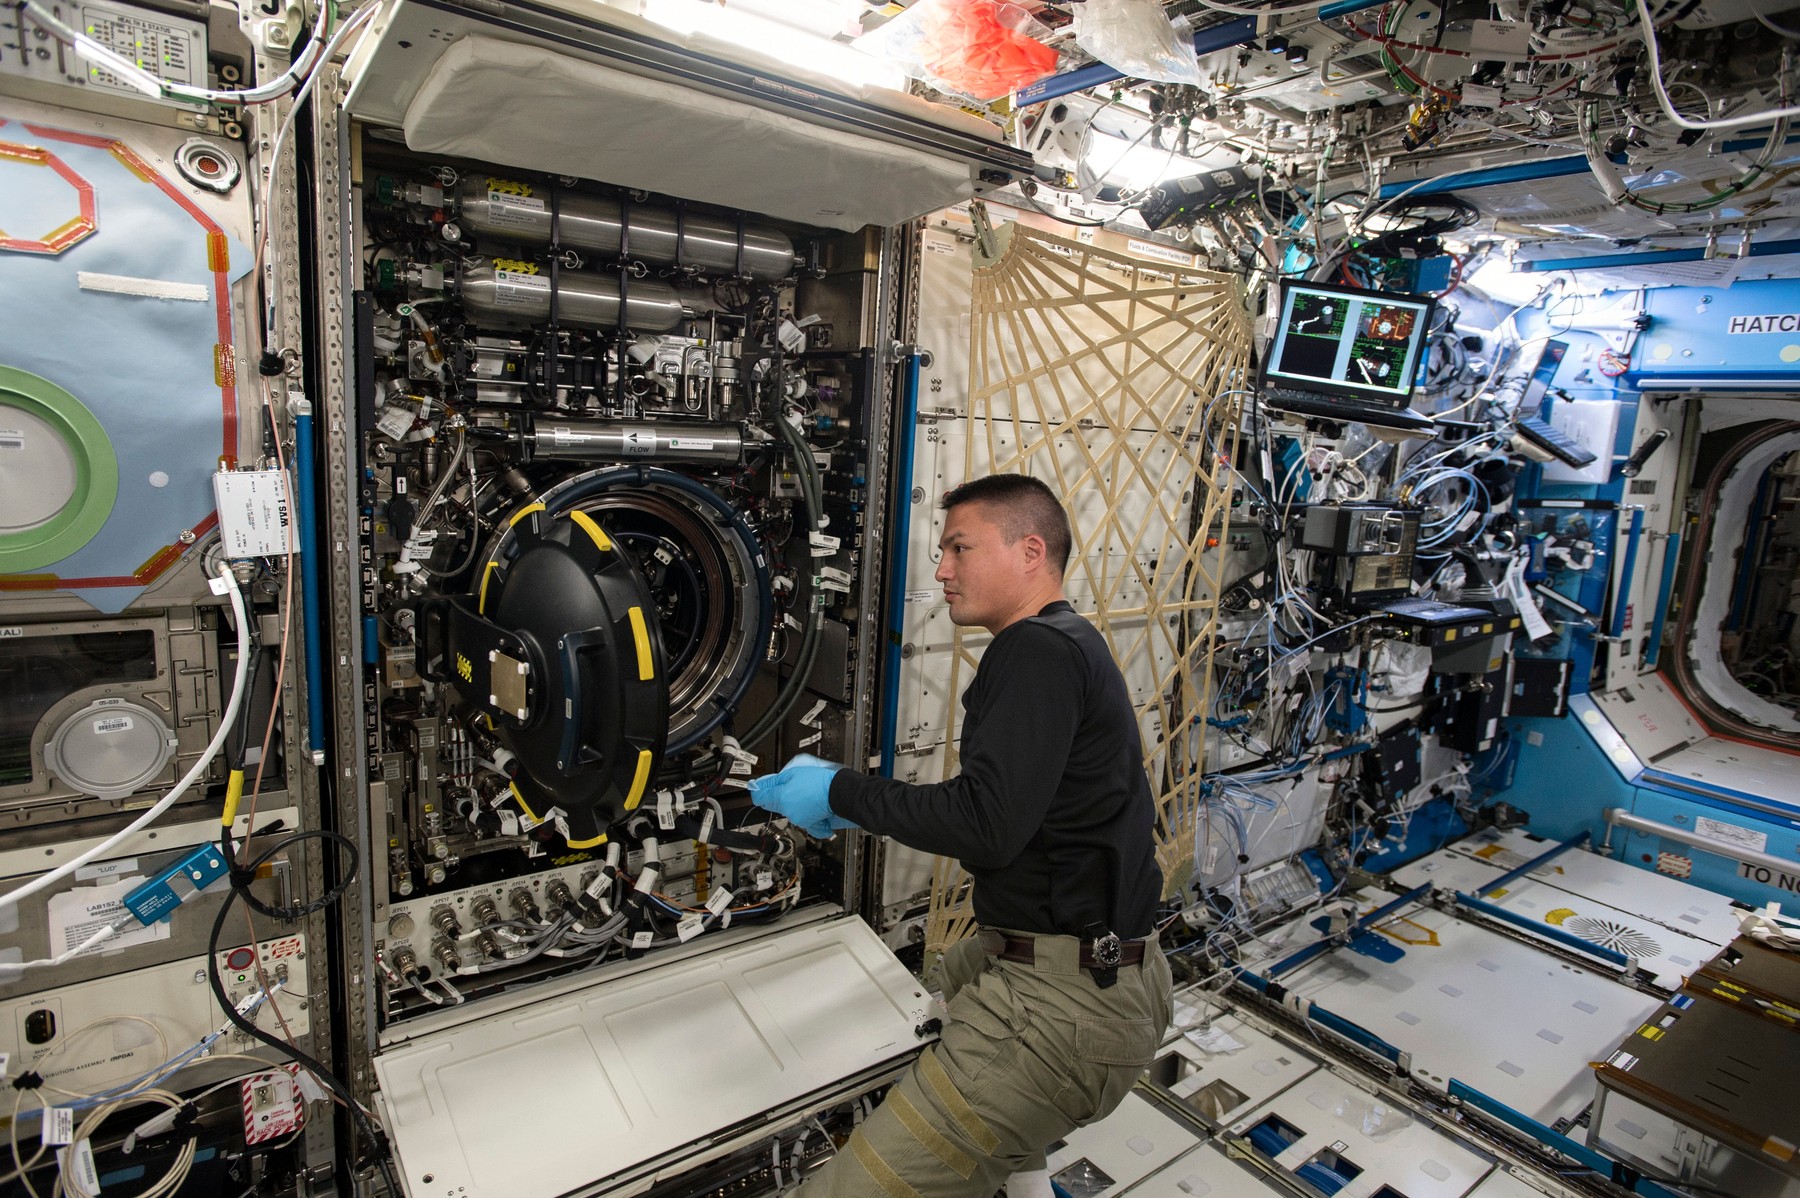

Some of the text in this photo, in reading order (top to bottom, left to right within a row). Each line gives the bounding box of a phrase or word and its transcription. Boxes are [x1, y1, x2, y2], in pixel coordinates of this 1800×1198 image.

[118, 16, 140, 26] HEALTH
[148, 24, 171, 34] STATUS
[1731, 315, 1800, 333] HATC
[279, 506, 288, 527] WVS
[1741, 862, 1771, 883] TO
[76, 1059, 106, 1070] ASSEMBLY
[110, 1051, 134, 1062] (RPDA)
[257, 1121, 294, 1136] RACK POWER
